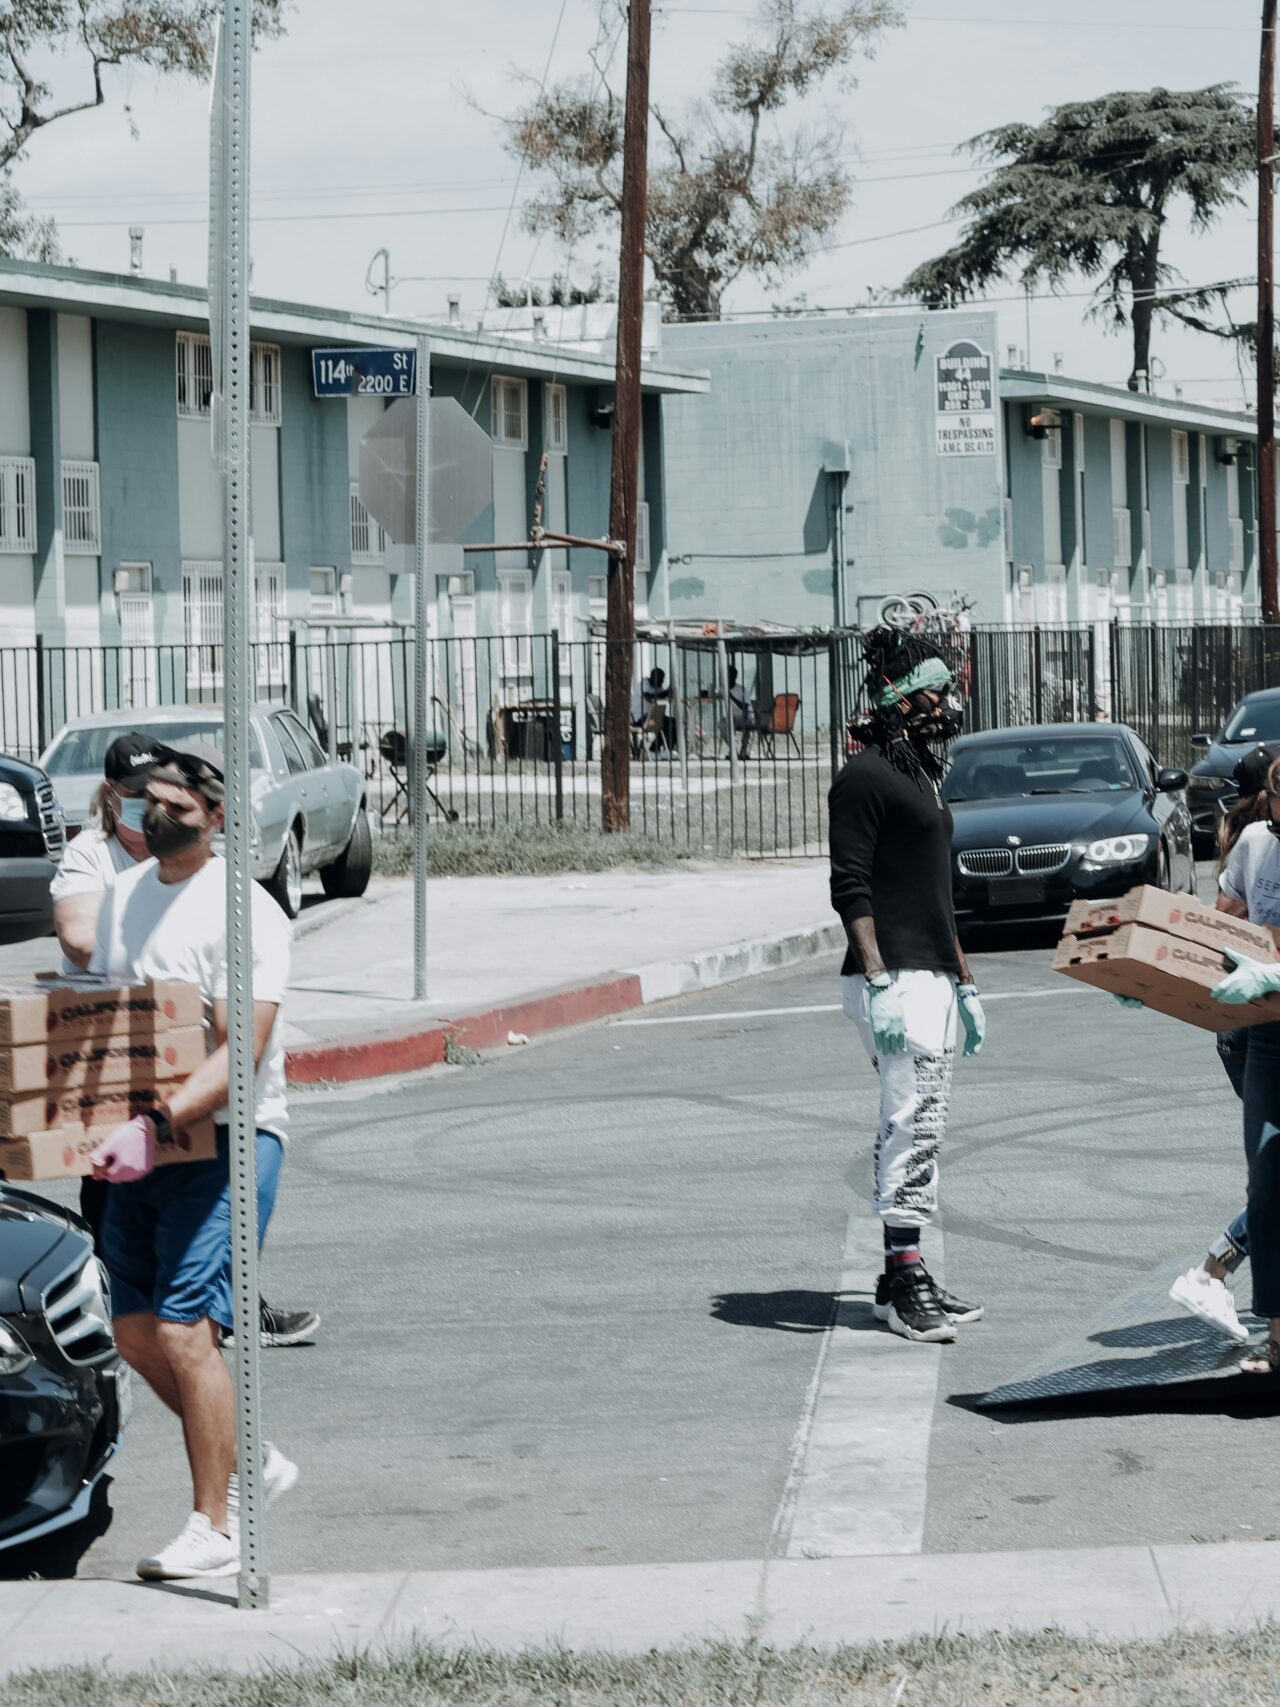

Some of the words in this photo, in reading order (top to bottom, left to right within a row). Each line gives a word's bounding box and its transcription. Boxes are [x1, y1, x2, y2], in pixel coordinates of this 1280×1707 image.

[393, 352, 408, 370] St
[940, 357, 988, 370] BUILDING
[954, 368, 972, 380] 44
[357, 374, 393, 393] 2200
[400, 374, 408, 392] E
[947, 390, 968, 401] UNIT
[959, 416, 971, 428] NO
[938, 428, 994, 440] TRESPASSING
[1184, 911, 1271, 952] CALIFORNIA
[1172, 948, 1224, 975] CALIFO
[60, 999, 159, 1022] CALIFORNIA
[60, 1045, 160, 1069] CALIFORNIA
